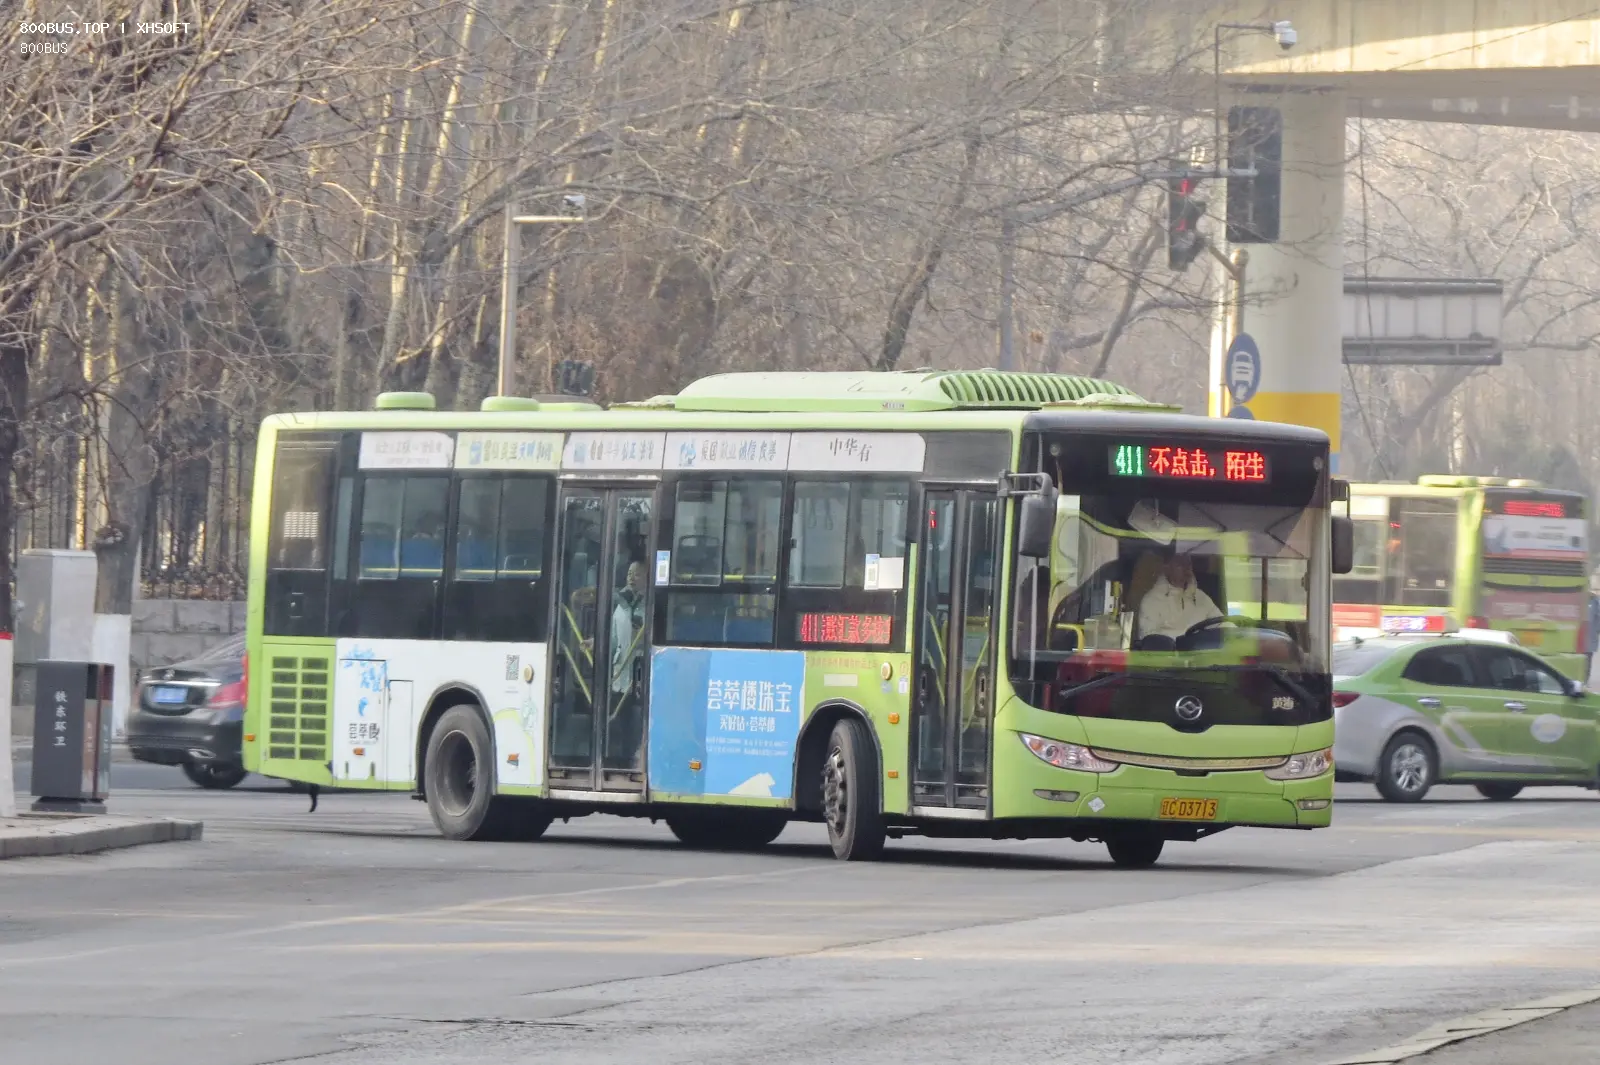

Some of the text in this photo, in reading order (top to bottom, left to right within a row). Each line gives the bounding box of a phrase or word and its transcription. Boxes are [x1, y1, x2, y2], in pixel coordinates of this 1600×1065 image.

[829, 437, 873, 463] 中华有
[1115, 445, 1142, 476] 411
[801, 612, 818, 642] 411
[707, 679, 793, 713] 荟萃楼珠宝
